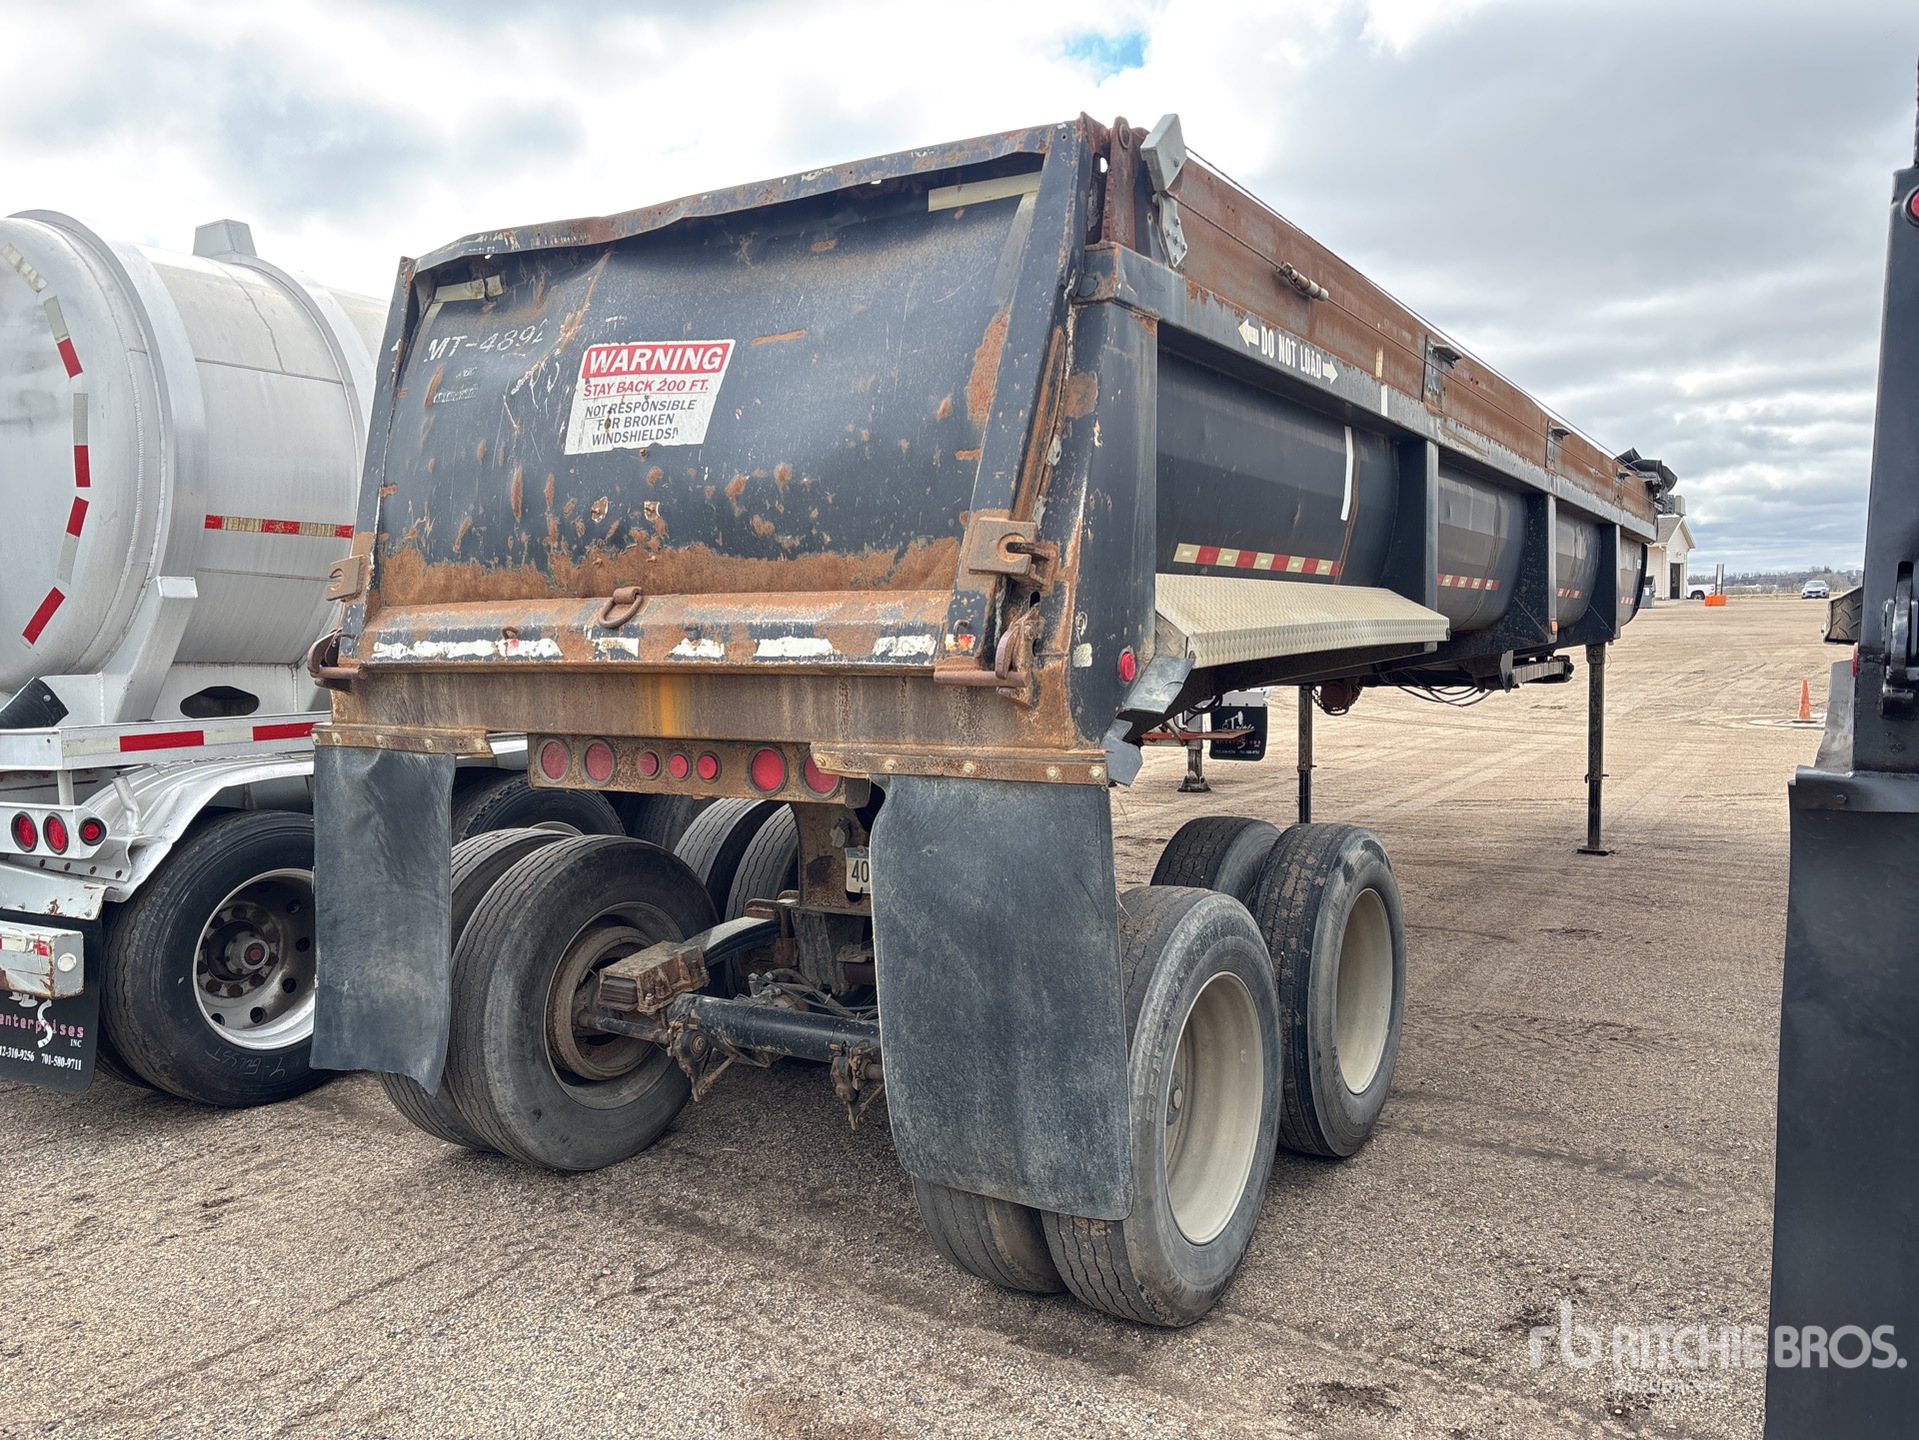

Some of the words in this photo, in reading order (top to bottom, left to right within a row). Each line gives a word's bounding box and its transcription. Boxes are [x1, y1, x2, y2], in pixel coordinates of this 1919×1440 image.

[589, 347, 724, 375] WARNING
[1261, 325, 1275, 359] DO
[1278, 334, 1297, 368] NOT
[1300, 344, 1322, 379] LOAD
[583, 382, 615, 398] STAY
[616, 380, 653, 394] BACK
[657, 379, 686, 392] 200
[689, 379, 709, 391] FT.
[585, 404, 607, 418] NOT
[610, 400, 697, 415] RESPONSIBLE
[597, 416, 620, 431] FR
[624, 413, 675, 428] BROKEN
[70, 1038, 82, 1048] INC
[41, 1053, 82, 1071] 701-580-9711
